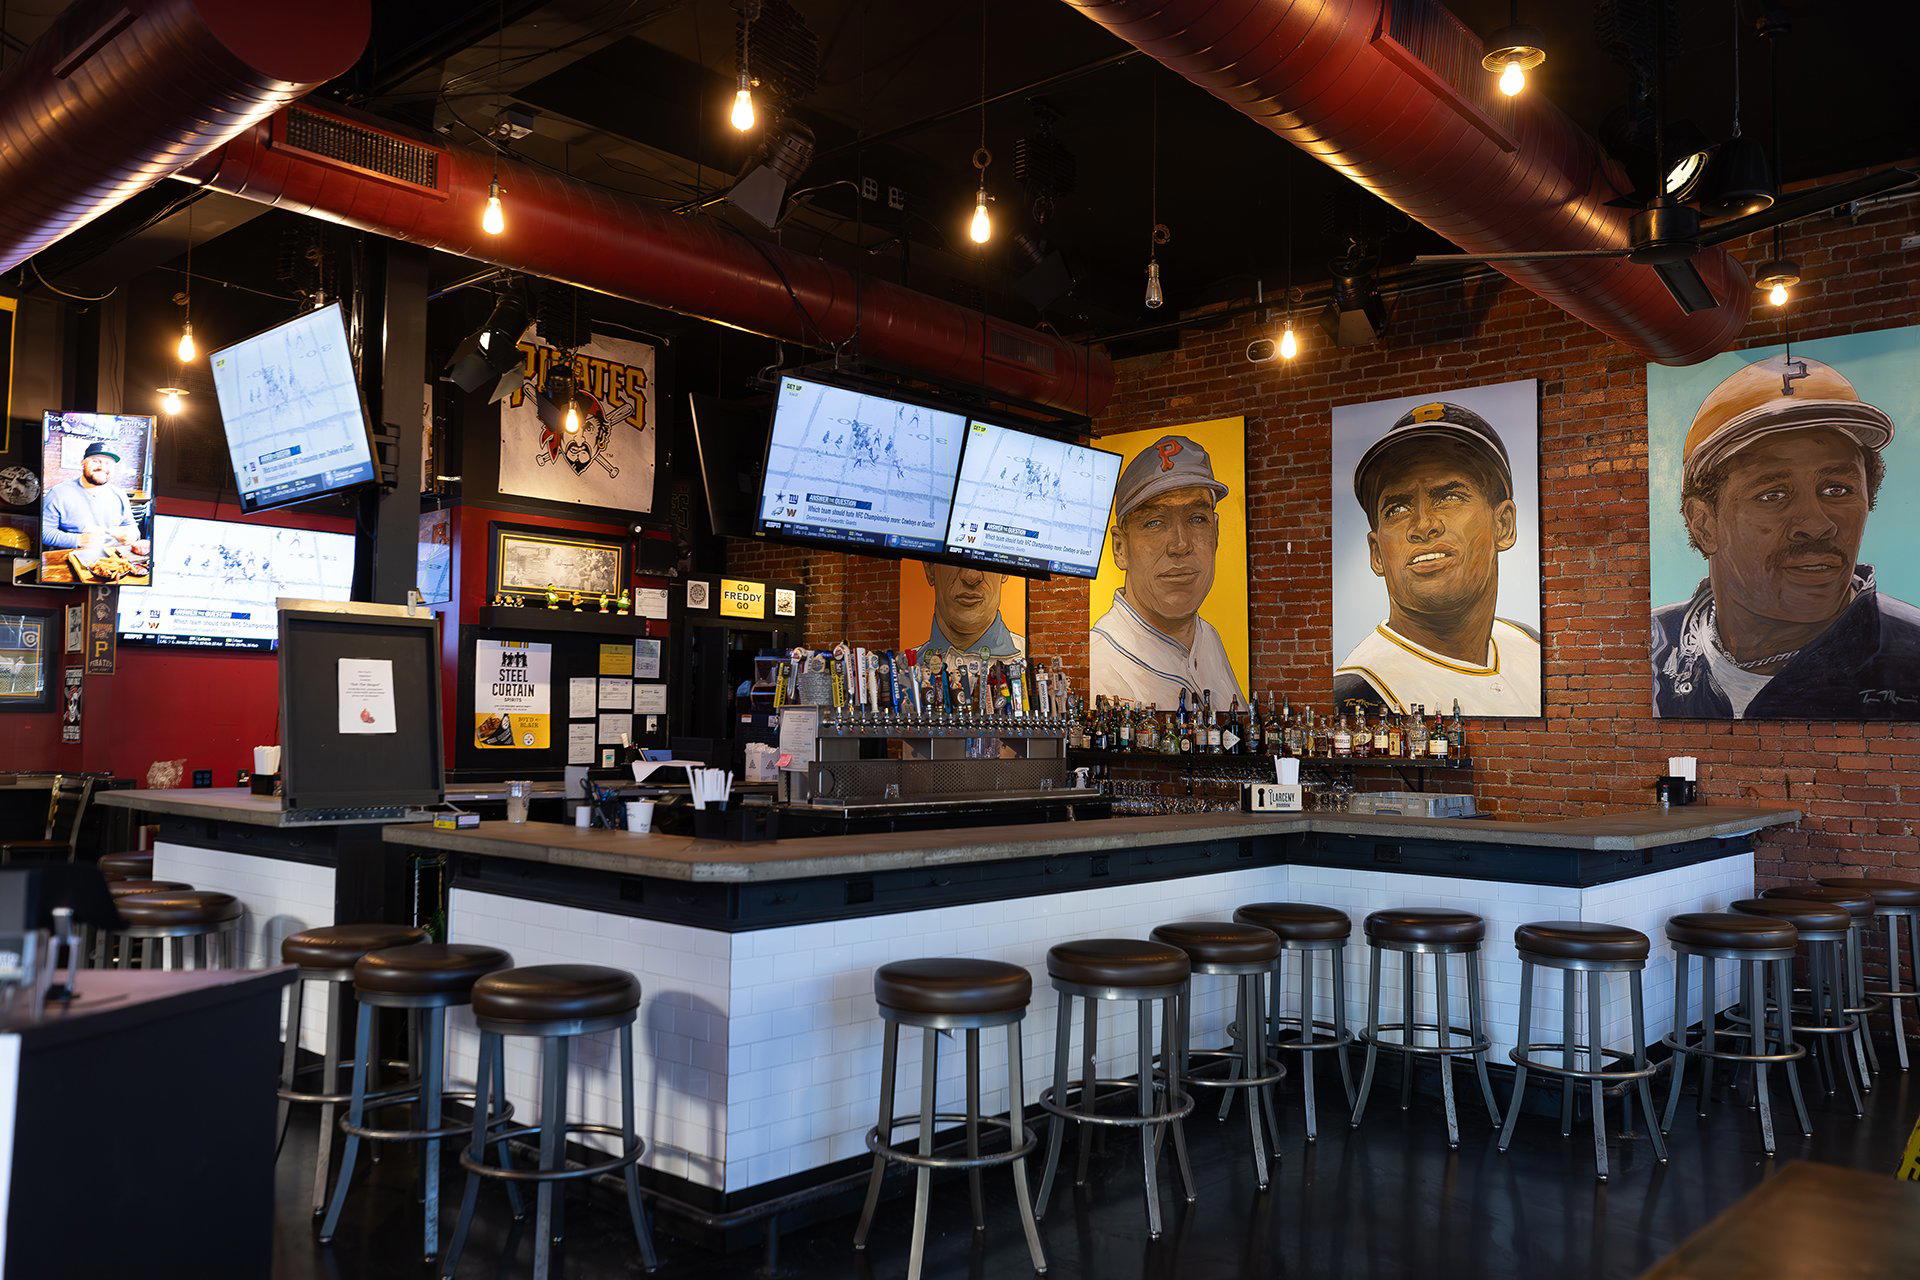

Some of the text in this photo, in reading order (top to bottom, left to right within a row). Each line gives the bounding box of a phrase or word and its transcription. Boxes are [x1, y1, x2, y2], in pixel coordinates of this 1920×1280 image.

[1156, 439, 1183, 473] P
[766, 521, 781, 529] ESPN
[737, 583, 750, 592] GO
[724, 591, 762, 603] FREDDY
[736, 602, 749, 610] GO
[95, 641, 109, 658] P
[499, 668, 529, 683] STEEL
[492, 682, 535, 698] CURTAIN
[1272, 792, 1296, 803] LARCENY
